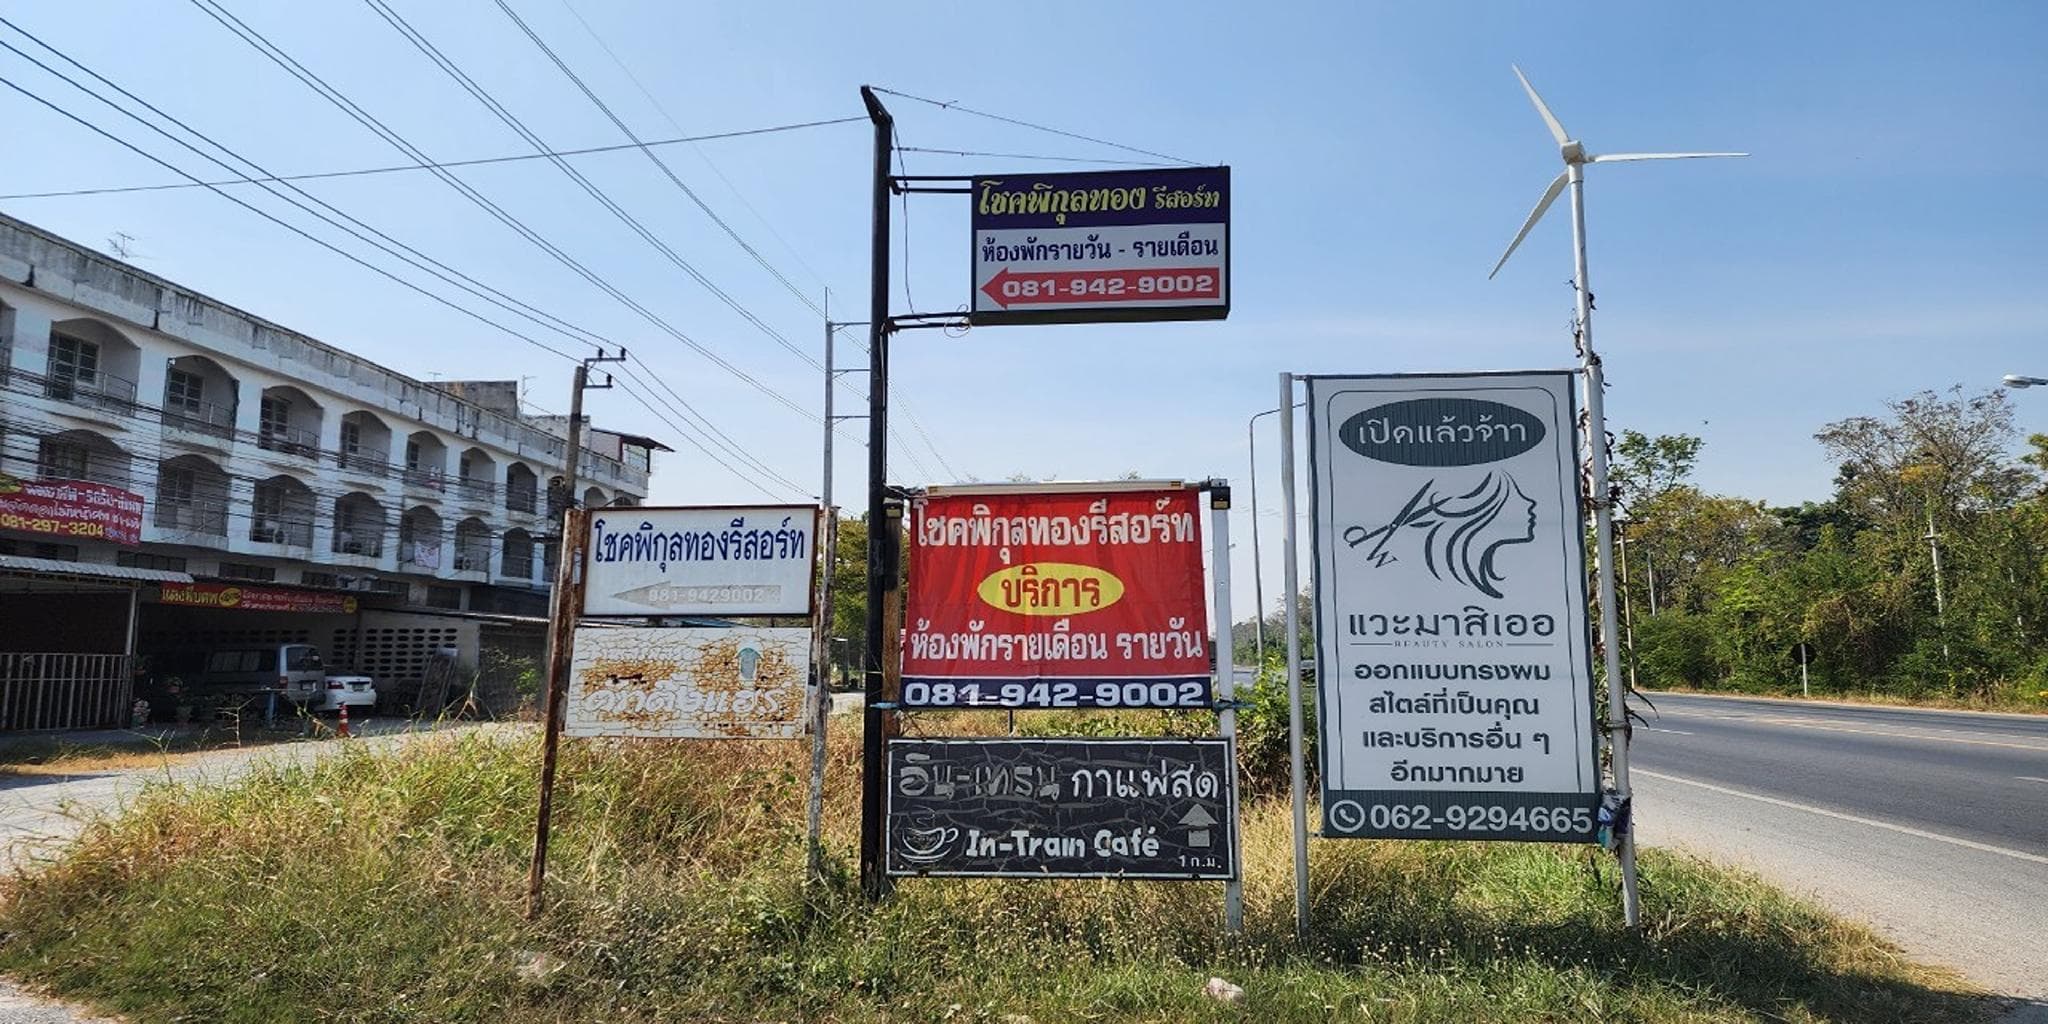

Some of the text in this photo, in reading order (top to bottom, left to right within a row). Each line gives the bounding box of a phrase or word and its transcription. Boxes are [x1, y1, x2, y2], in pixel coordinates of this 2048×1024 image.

[978, 181, 1220, 225] โชคพิกุลทอง รีสอร์ท
[982, 234, 1112, 262] ห้องพักรายวัน
[1133, 231, 1219, 258] รายเดือน
[1002, 275, 1213, 297] 081-942-9002
[0, 513, 105, 538] 081-297-3204
[913, 497, 1195, 564] โชคพิกุลทองรีสอร์ท
[594, 517, 806, 573] โชคพิกุลทองรีสอร์ท
[1001, 565, 1101, 607] บริการ
[1349, 606, 1556, 637] แวะมาสิเออ
[911, 617, 1204, 662] ห้องพักรายเดือน รายวัน
[1394, 640, 1504, 649] BEAUTY SALON
[1354, 663, 1551, 681] ออกแบบทรงผม
[904, 681, 1205, 708] 081-942-9002
[1369, 690, 1540, 721] สไตล์ที่เป็นคุณ
[1071, 760, 1219, 800] กาแฟสด
[1391, 761, 1525, 784] อีกมากมาย
[1369, 804, 1593, 834] 062-9294665
[1094, 826, 1160, 858] Café
